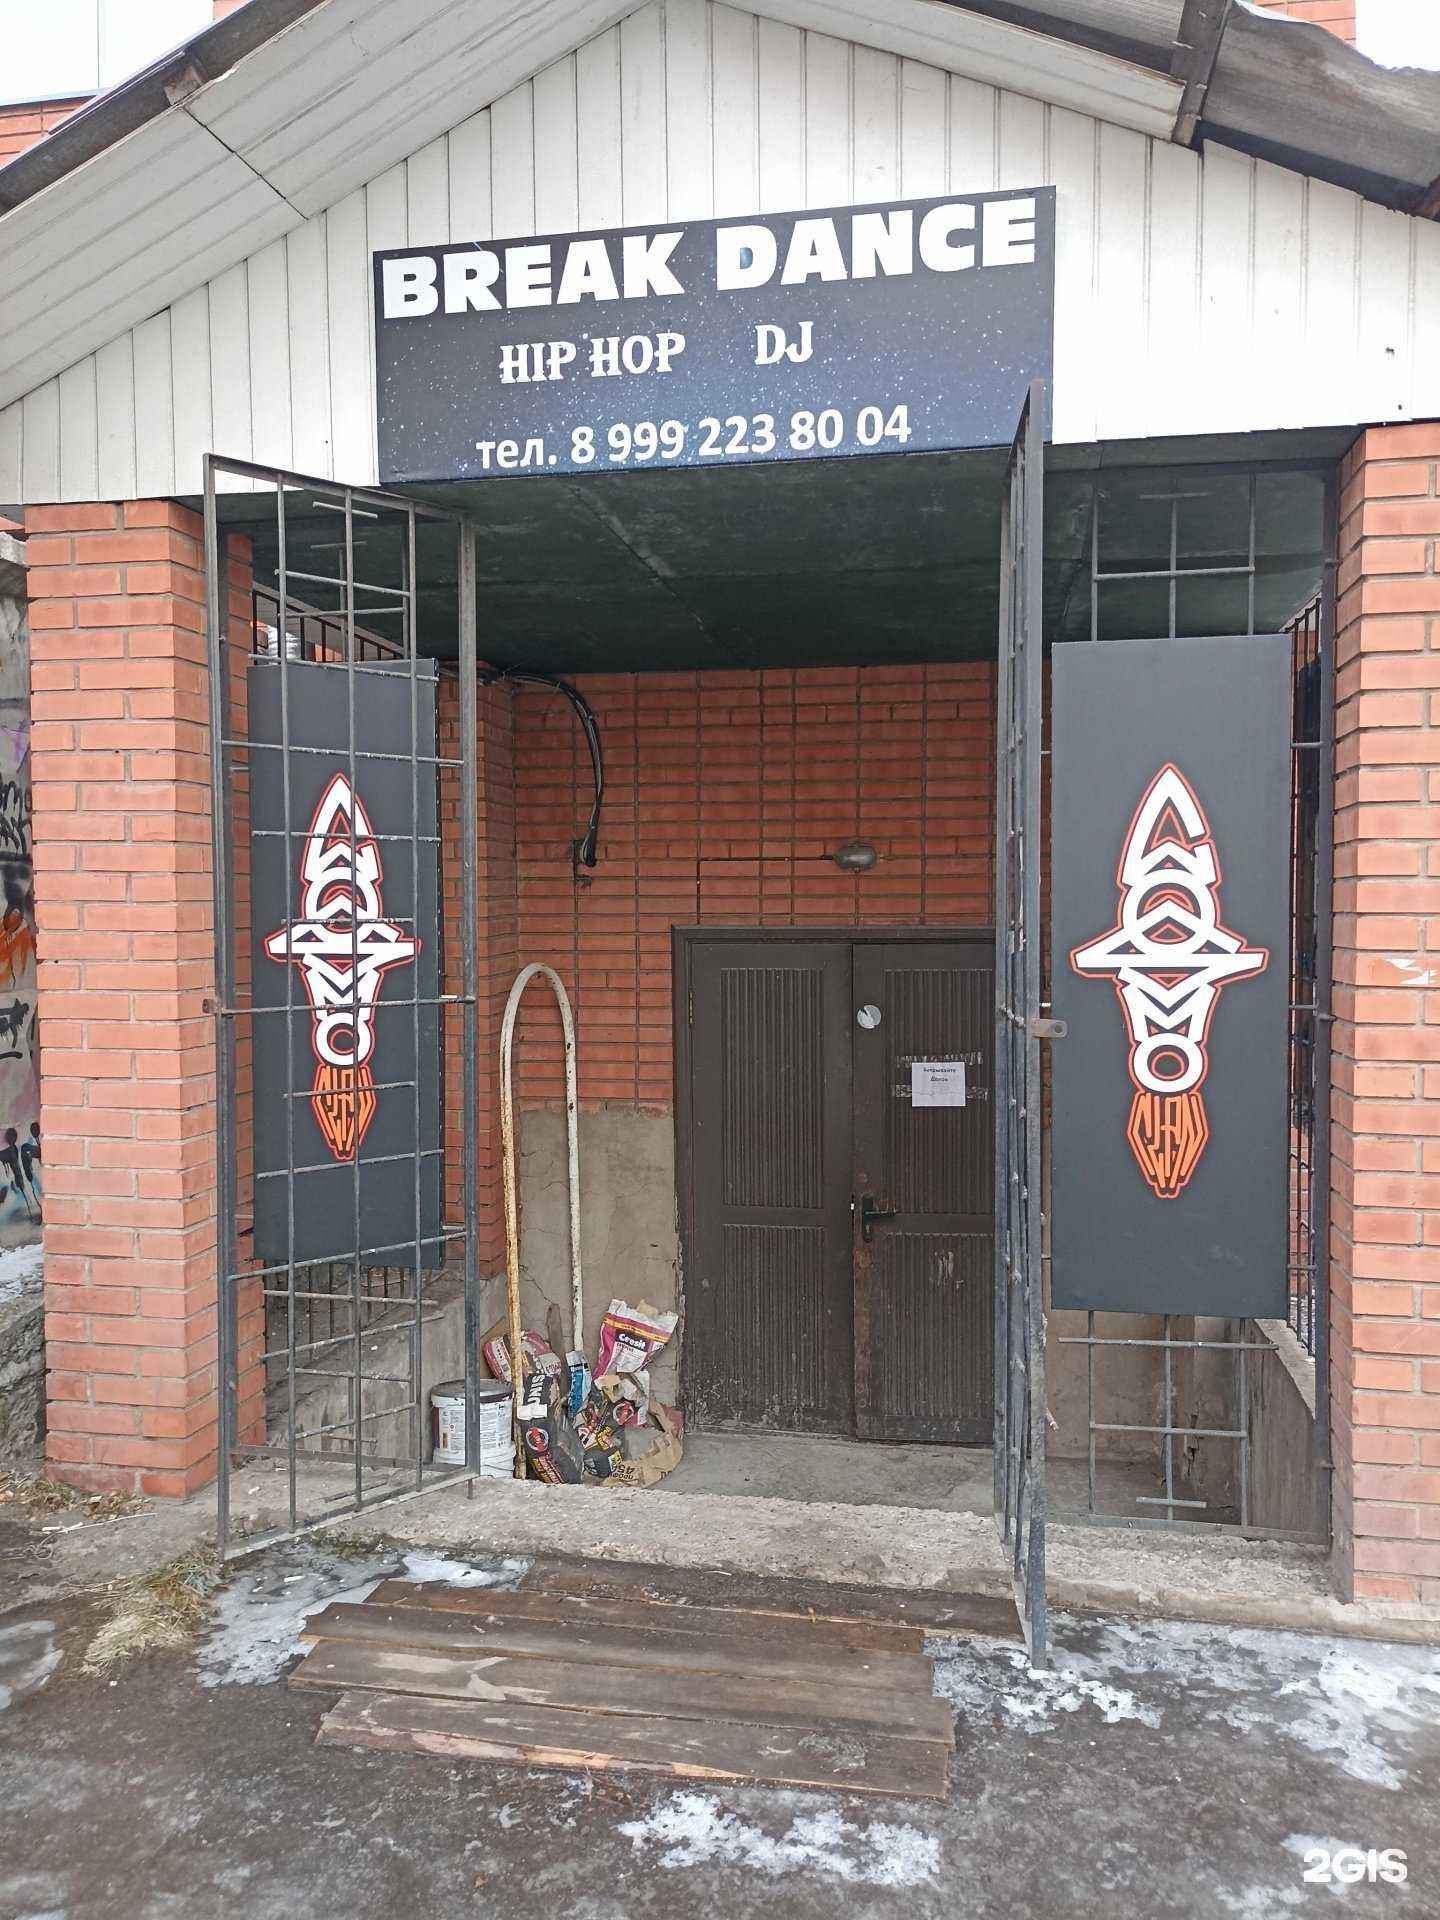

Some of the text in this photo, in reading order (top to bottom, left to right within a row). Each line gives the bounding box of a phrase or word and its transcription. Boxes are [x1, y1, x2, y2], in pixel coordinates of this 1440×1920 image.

[382, 197, 1036, 319] BREAK DANCE
[499, 332, 686, 384] HIP HOP
[754, 321, 814, 366] DJ
[476, 404, 911, 470] тел. 8 999 223 80 04
